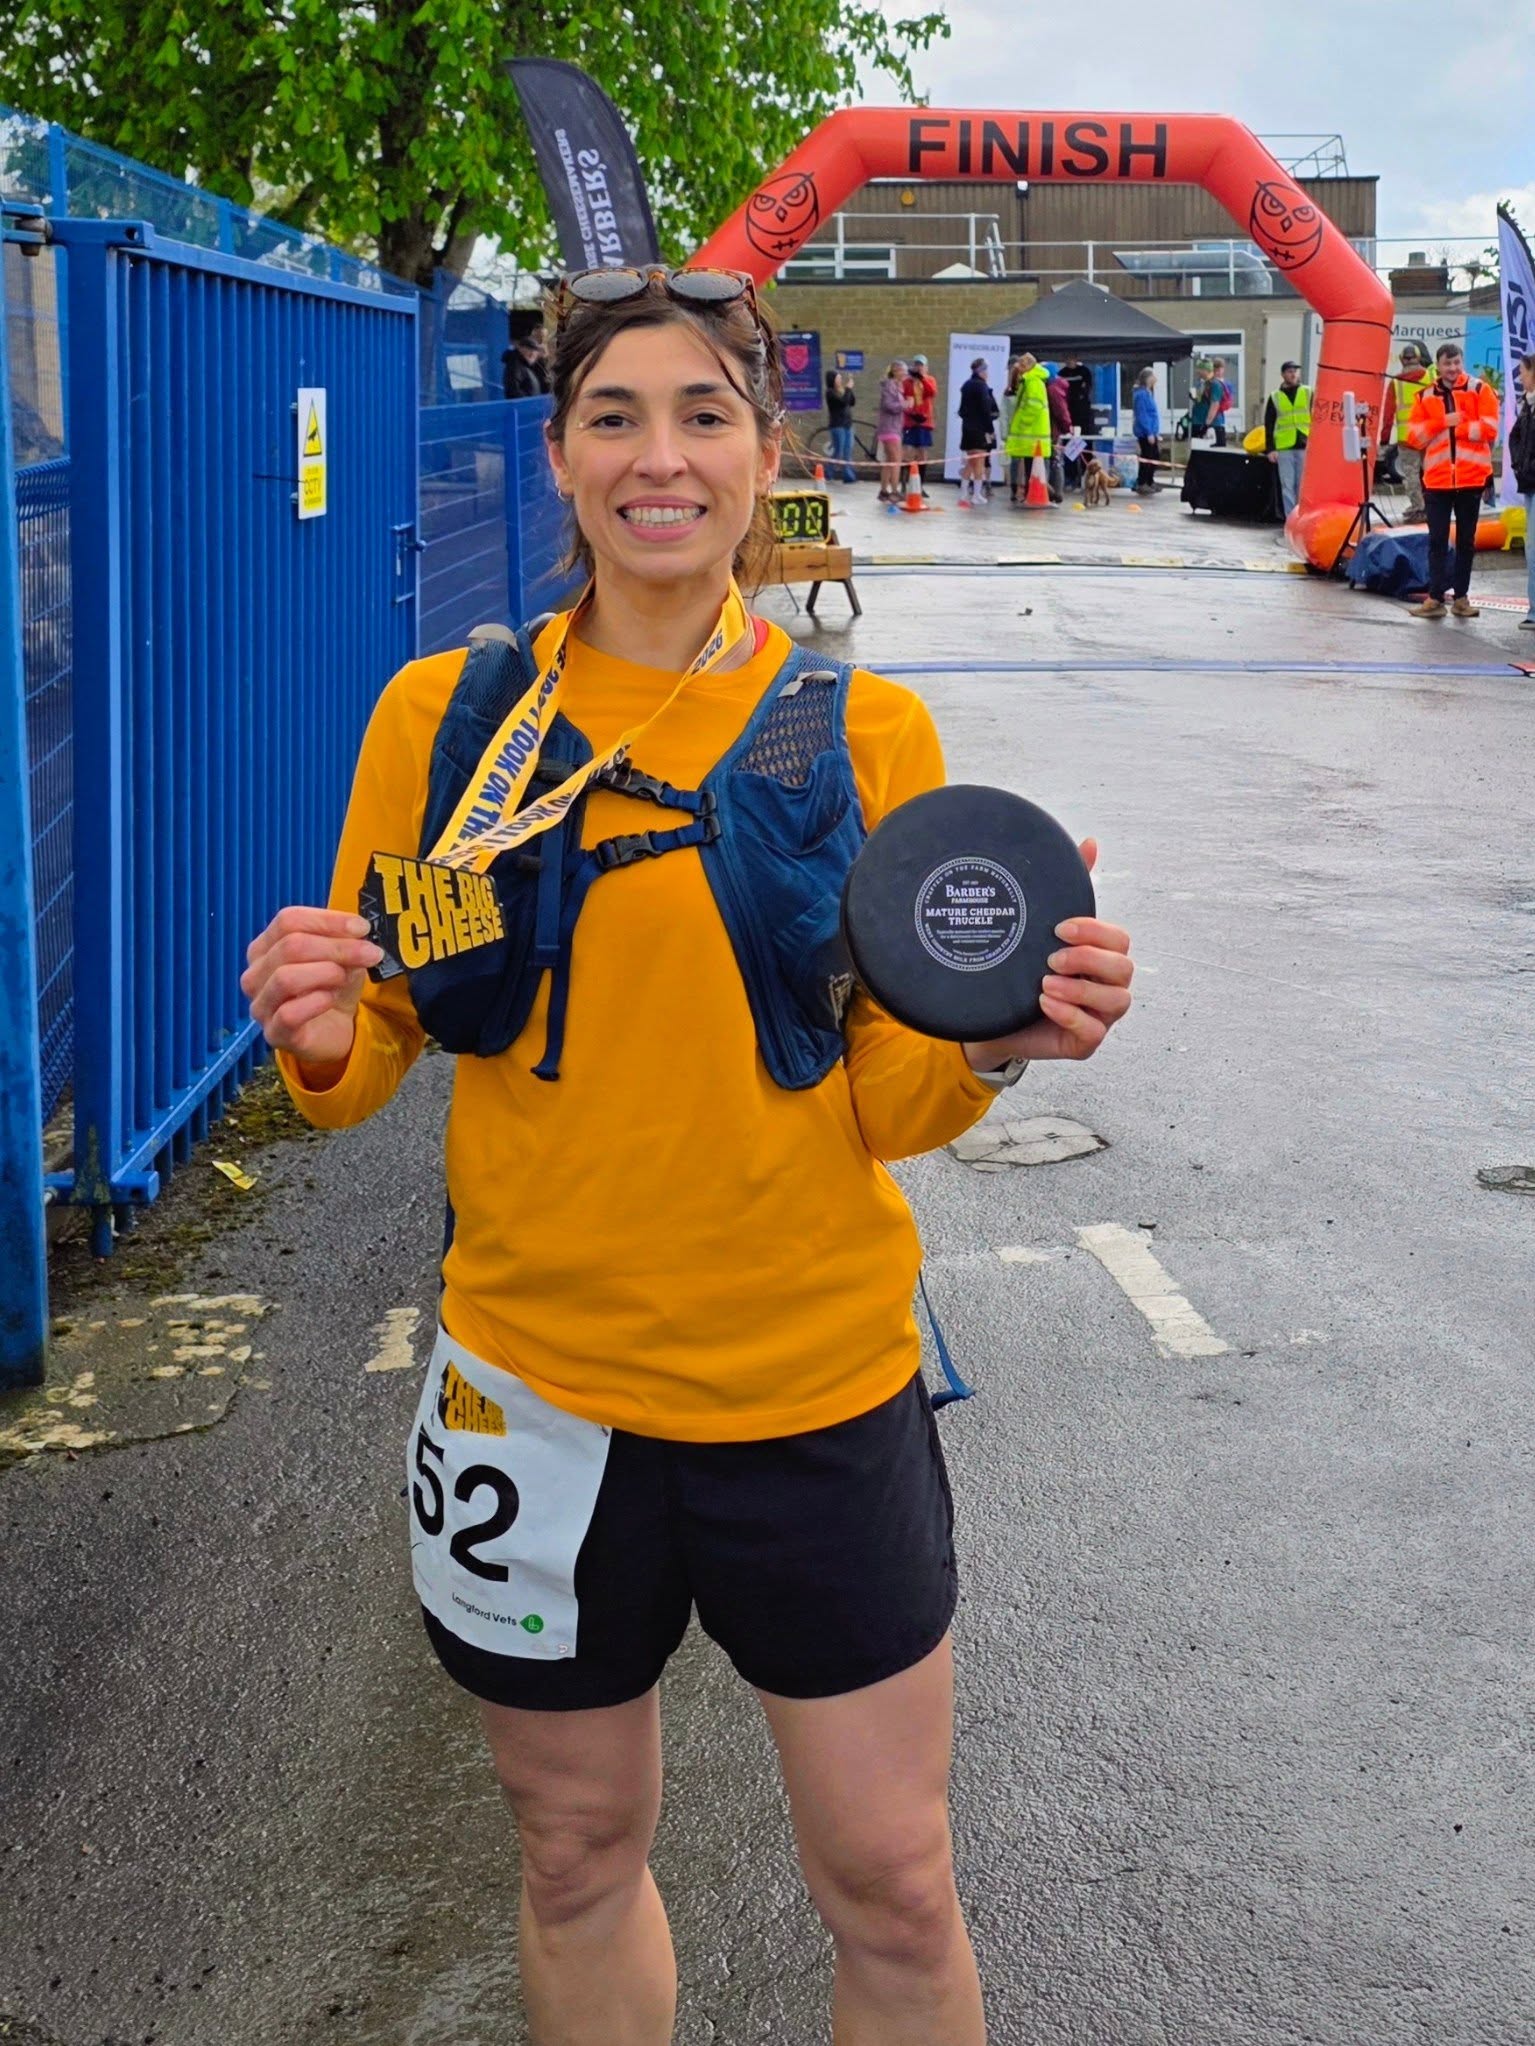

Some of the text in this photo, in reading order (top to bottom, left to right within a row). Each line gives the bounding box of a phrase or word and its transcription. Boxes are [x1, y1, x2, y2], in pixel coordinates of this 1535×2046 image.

[908, 118, 1167, 178] FINISH
[1391, 324, 1461, 340] Marquees
[494, 718, 540, 782] TOOK
[492, 804, 561, 837] TOOK
[373, 853, 462, 915] THE
[456, 871, 496, 911] BIG
[970, 864, 989, 873] FARM
[945, 884, 996, 898] BARBER'S
[925, 907, 1016, 917] MATURE CHEDDAR
[948, 916, 993, 926] TRUCKLE
[397, 907, 505, 969] CHEESE
[445, 1361, 484, 1412] THE
[445, 1399, 507, 1437] CHEESE
[413, 1422, 520, 1582] 52
[452, 1592, 517, 1626] Langford Vets
